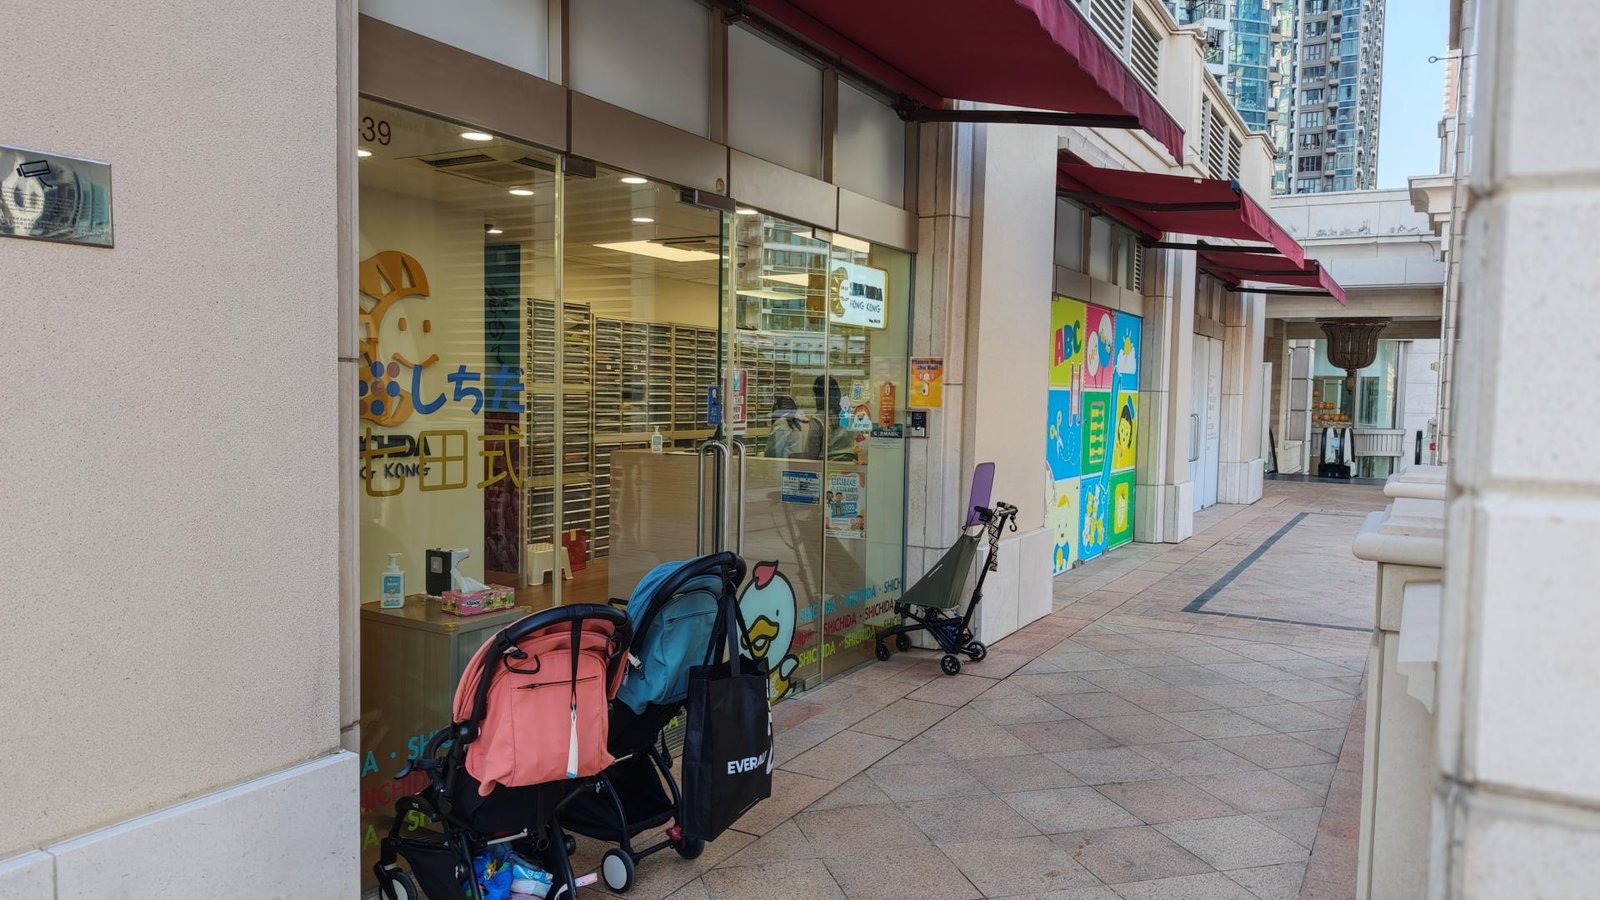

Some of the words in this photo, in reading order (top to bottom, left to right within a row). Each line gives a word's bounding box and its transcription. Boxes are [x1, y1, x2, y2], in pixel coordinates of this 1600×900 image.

[1054, 319, 1082, 368] ABC
[411, 363, 526, 415] しちだ
[359, 423, 524, 497] 七田式
[384, 462, 432, 479] KONG
[824, 612, 857, 635] SHICHIDA
[864, 598, 894, 620] SHICHIDA
[799, 641, 836, 667] SHICIDA
